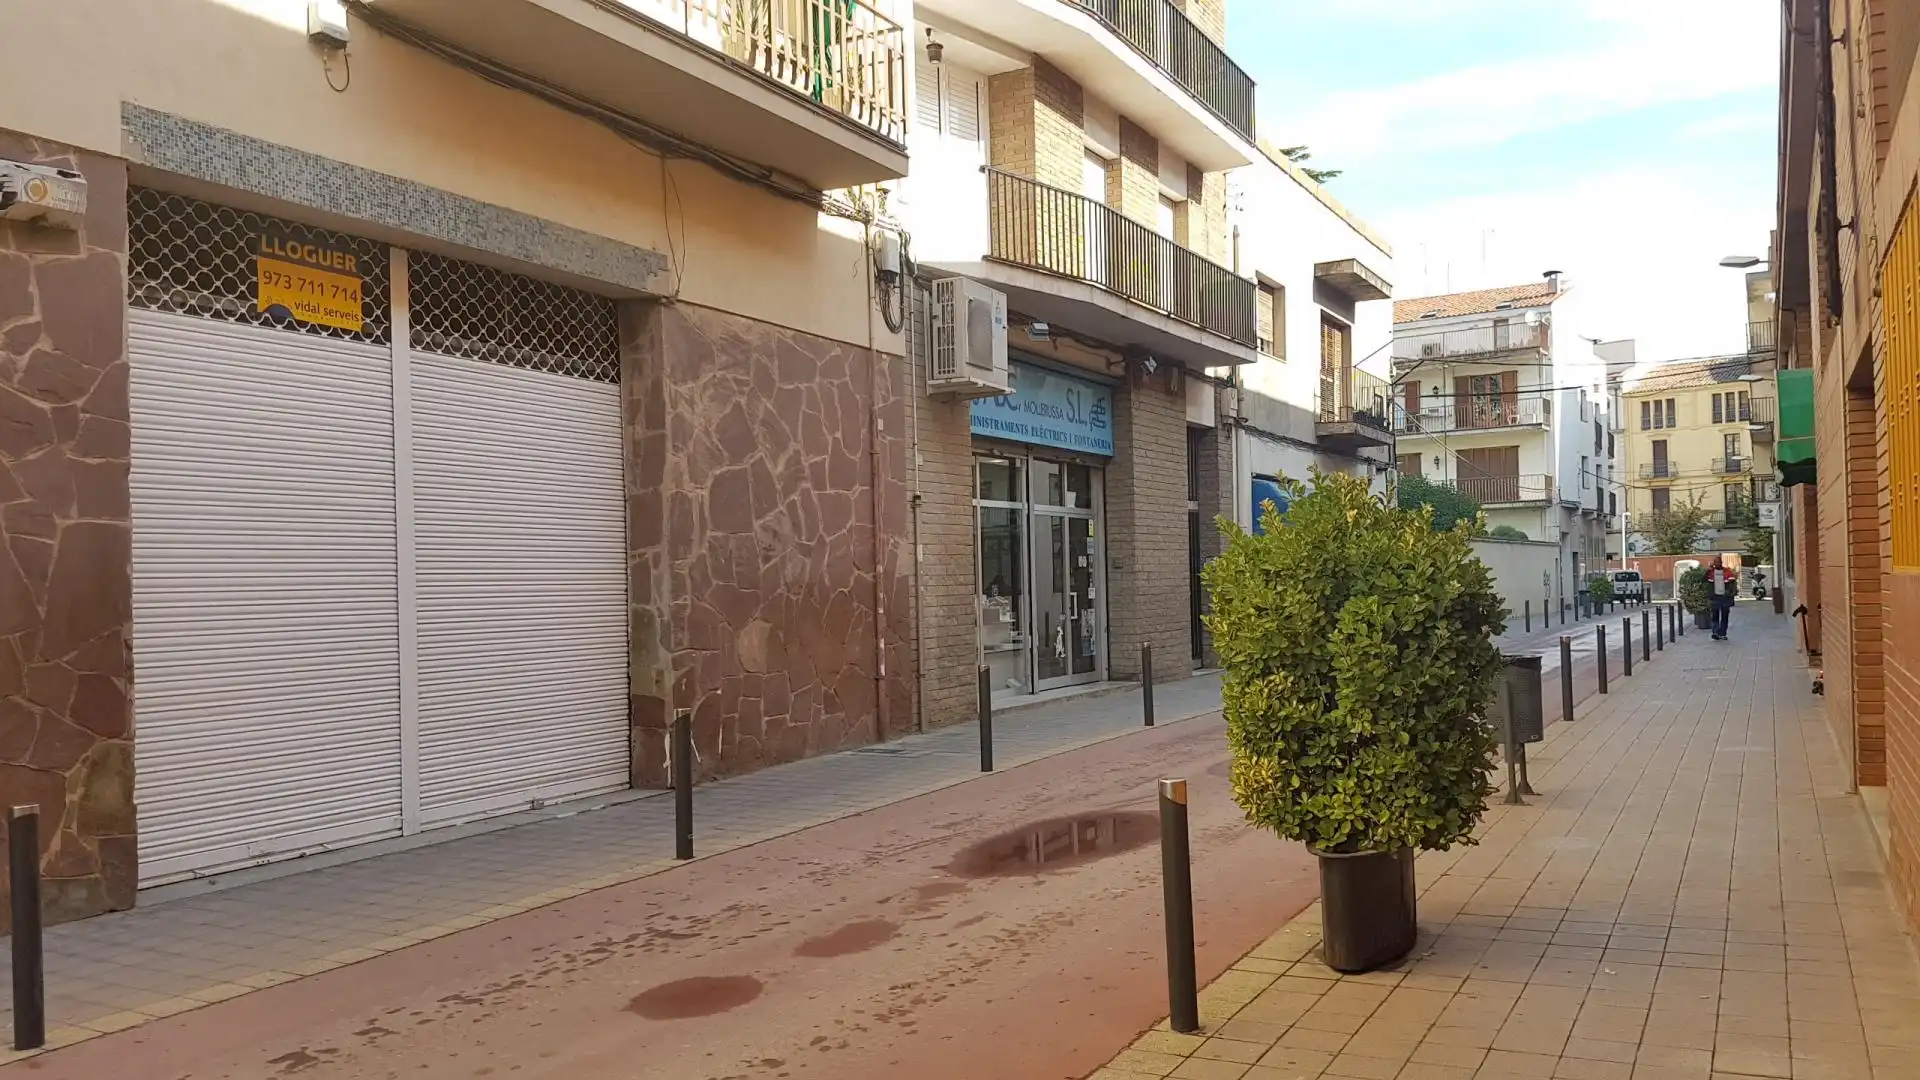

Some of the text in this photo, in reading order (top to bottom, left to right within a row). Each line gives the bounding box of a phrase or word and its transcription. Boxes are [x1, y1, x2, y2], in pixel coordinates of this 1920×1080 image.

[261, 234, 357, 272] LLOGUER
[263, 270, 358, 304] 973 711 714
[294, 300, 320, 314] vidal
[323, 306, 360, 322] serveis
